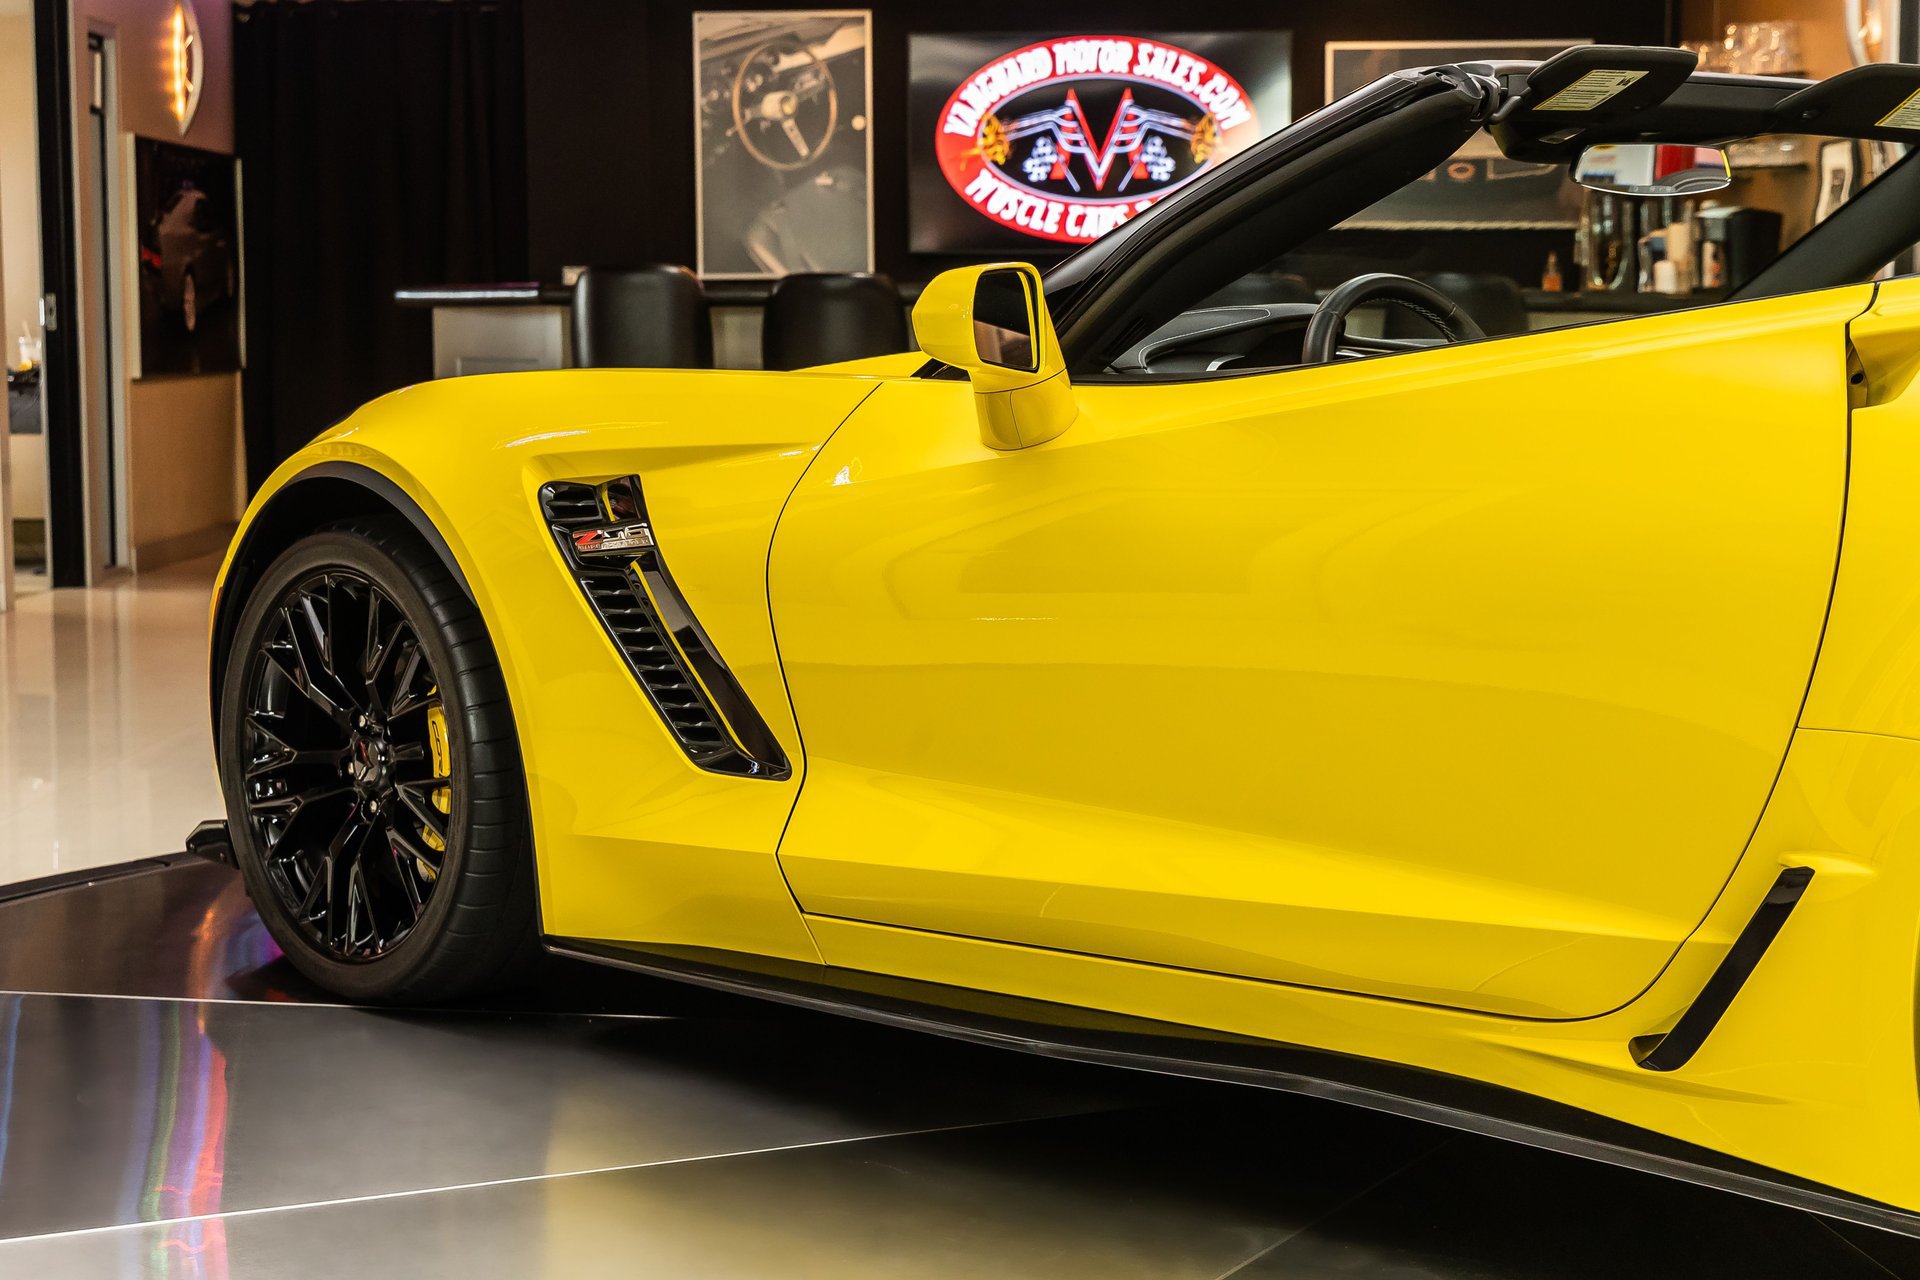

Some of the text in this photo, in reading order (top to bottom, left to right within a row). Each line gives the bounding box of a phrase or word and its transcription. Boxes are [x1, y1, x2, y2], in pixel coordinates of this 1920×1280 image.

[943, 39, 1252, 137] VANGUARD MOTOR SALES.COM
[964, 168, 1065, 235] MUSCLE
